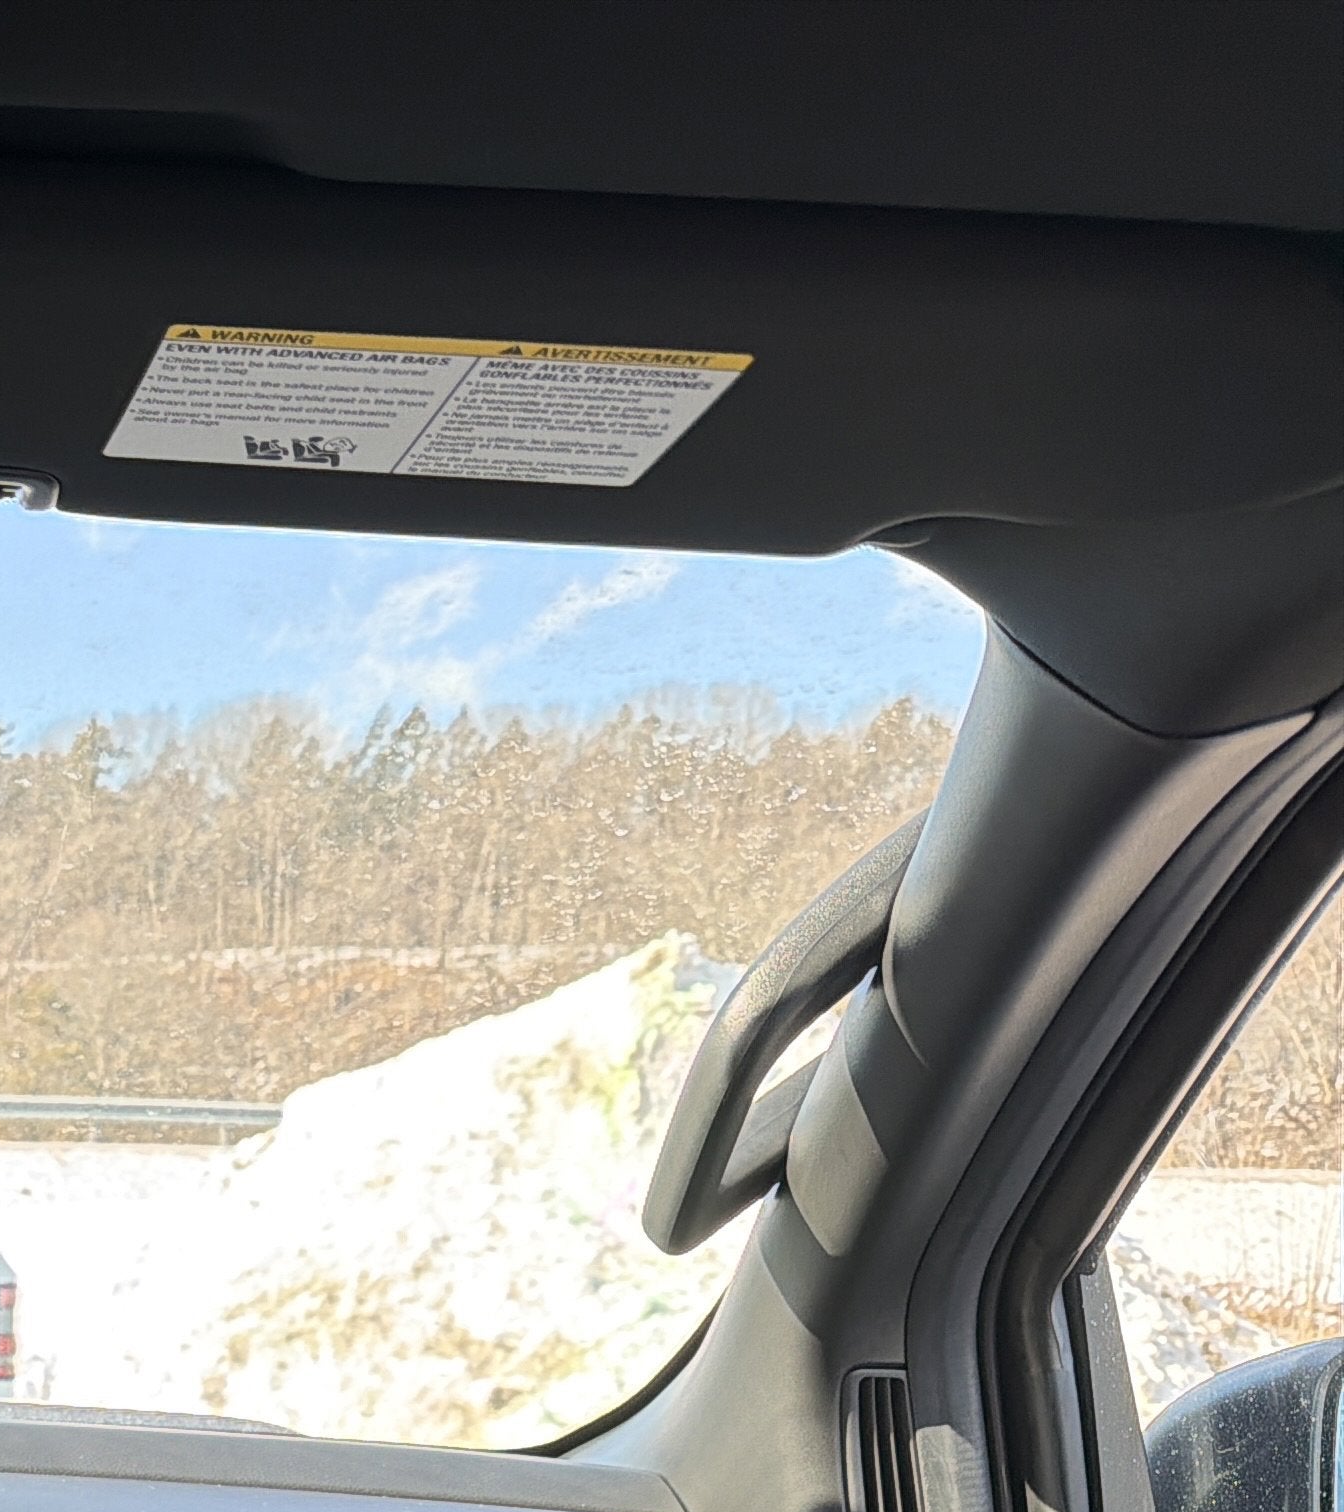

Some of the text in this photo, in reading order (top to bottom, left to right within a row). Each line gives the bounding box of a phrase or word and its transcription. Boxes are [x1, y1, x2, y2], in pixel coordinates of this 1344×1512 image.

[210, 330, 315, 345] WARNING
[165, 343, 453, 367] EVEN WITH ADVANCED AIR BAGS
[533, 347, 717, 366] AVERTISSEMENT
